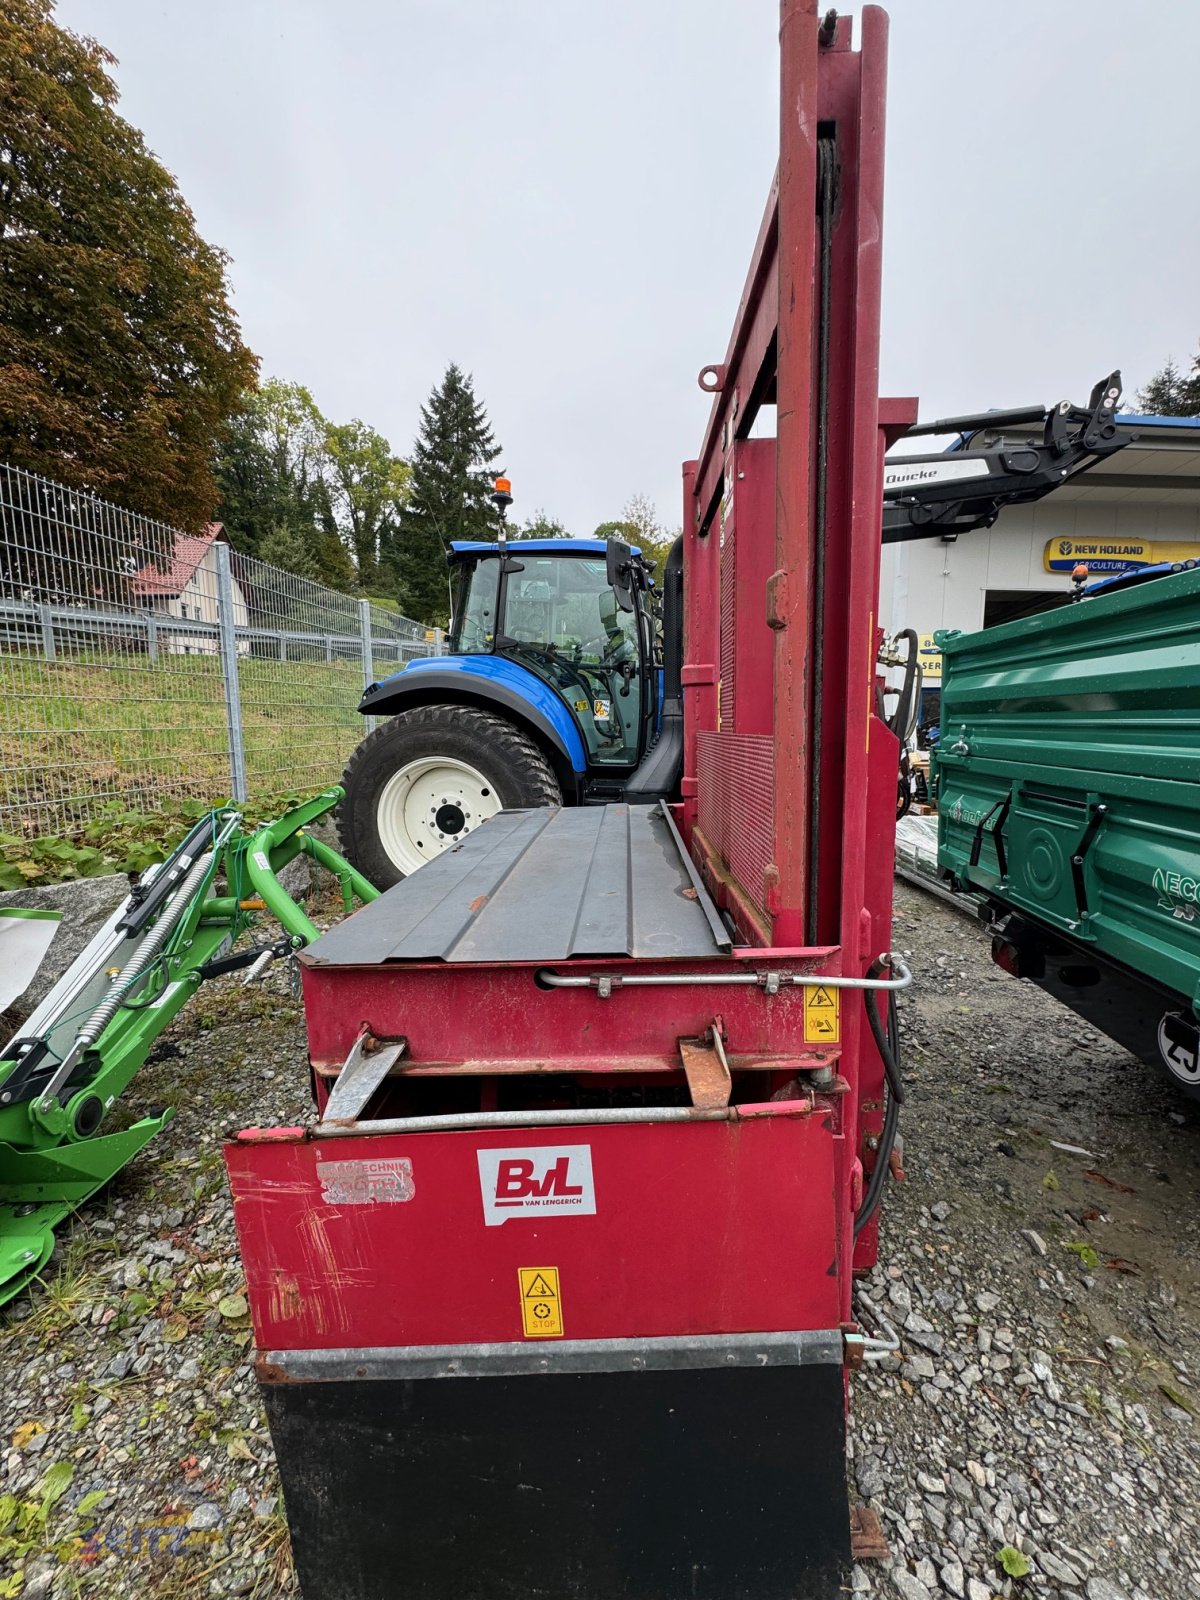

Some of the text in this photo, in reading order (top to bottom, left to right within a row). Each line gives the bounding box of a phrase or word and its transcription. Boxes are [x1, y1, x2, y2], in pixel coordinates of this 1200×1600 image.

[886, 470, 938, 484] Quicke
[1074, 544, 1144, 555] NEW HOLLAND
[495, 1157, 583, 1199] BvL
[525, 1197, 582, 1207] VAN LENGERICH
[532, 1320, 556, 1329] STOP
